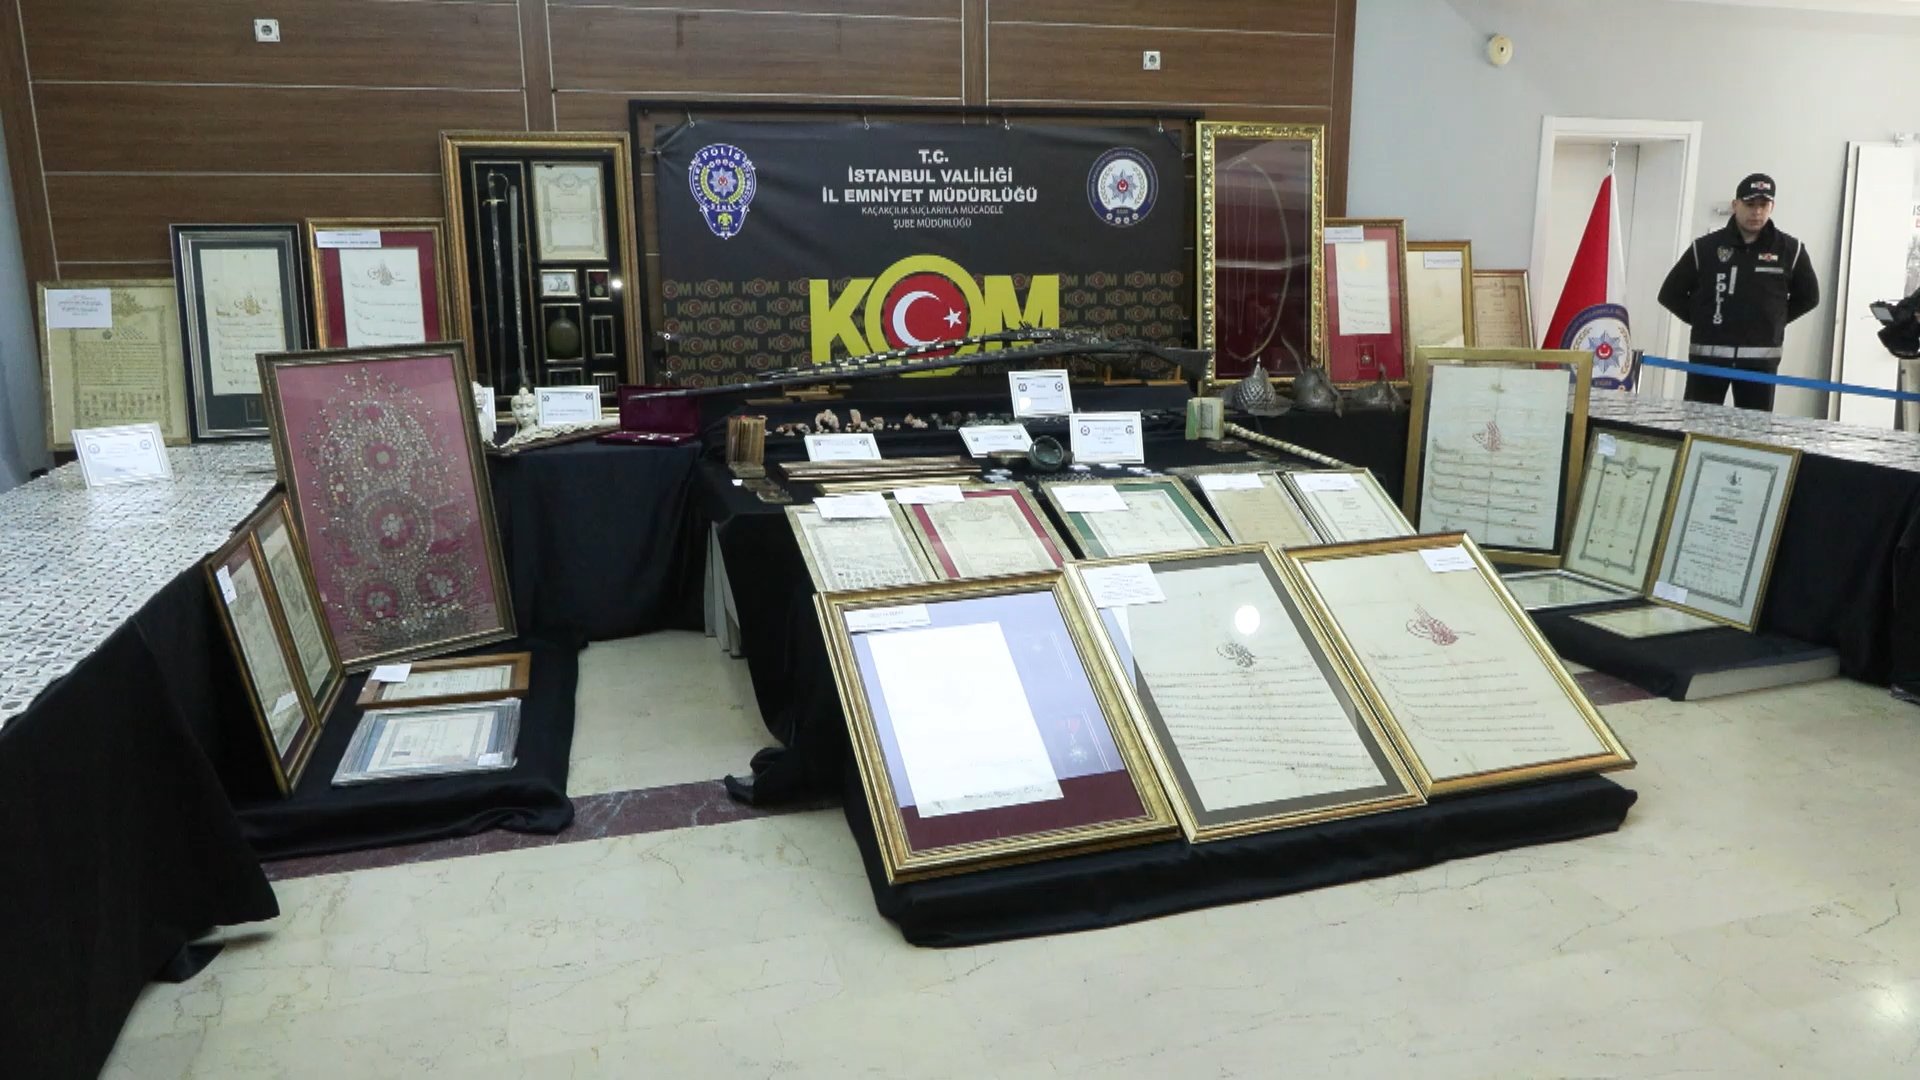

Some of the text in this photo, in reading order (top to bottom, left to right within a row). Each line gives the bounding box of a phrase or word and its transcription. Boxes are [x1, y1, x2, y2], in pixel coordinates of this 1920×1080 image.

[918, 149, 949, 164] T.C.
[848, 166, 1013, 183] İSTANBUL VALİLİĞİ
[822, 186, 1038, 203] İL EMNİYET MÜDÜRLÜĞÜ
[809, 254, 1060, 378] KOM
